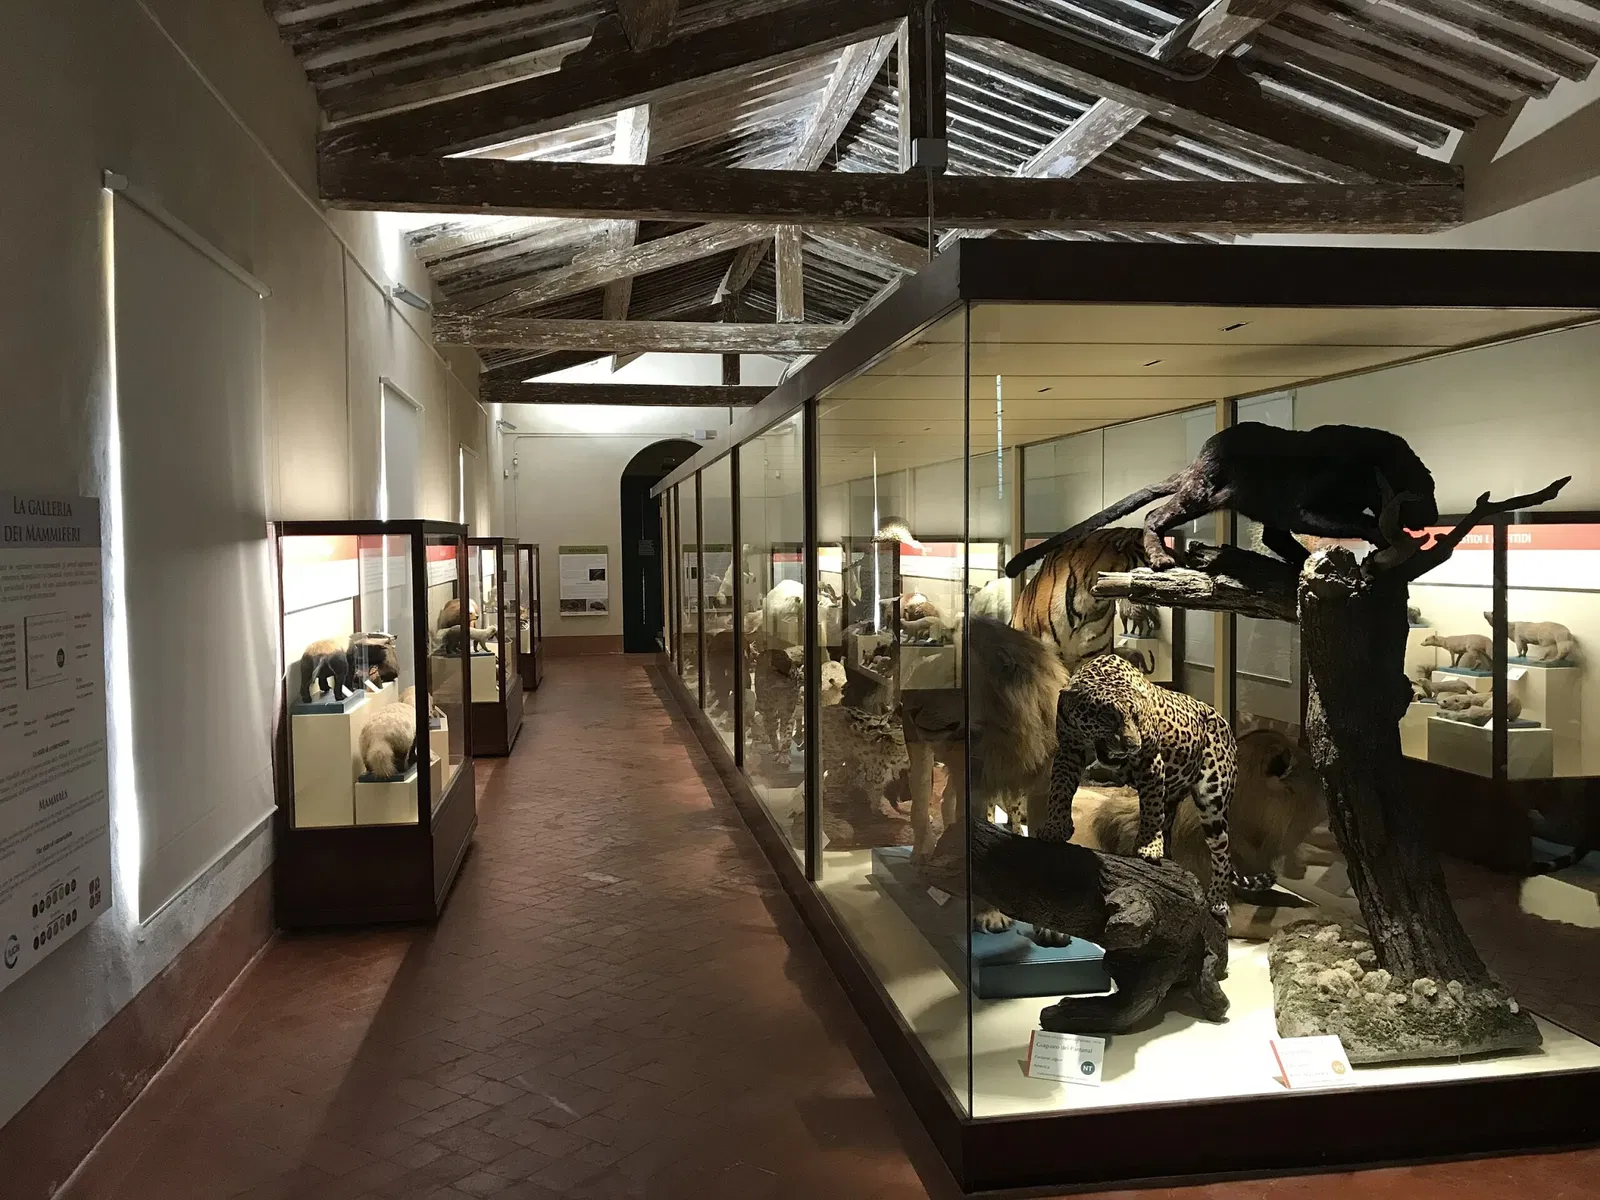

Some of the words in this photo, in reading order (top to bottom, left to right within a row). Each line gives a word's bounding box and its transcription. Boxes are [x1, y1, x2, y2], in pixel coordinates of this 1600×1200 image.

[13, 495, 26, 515] LA
[28, 499, 72, 517] GALLERIA
[4, 525, 22, 542] DEI
[25, 524, 81, 543] MAMMIFERI
